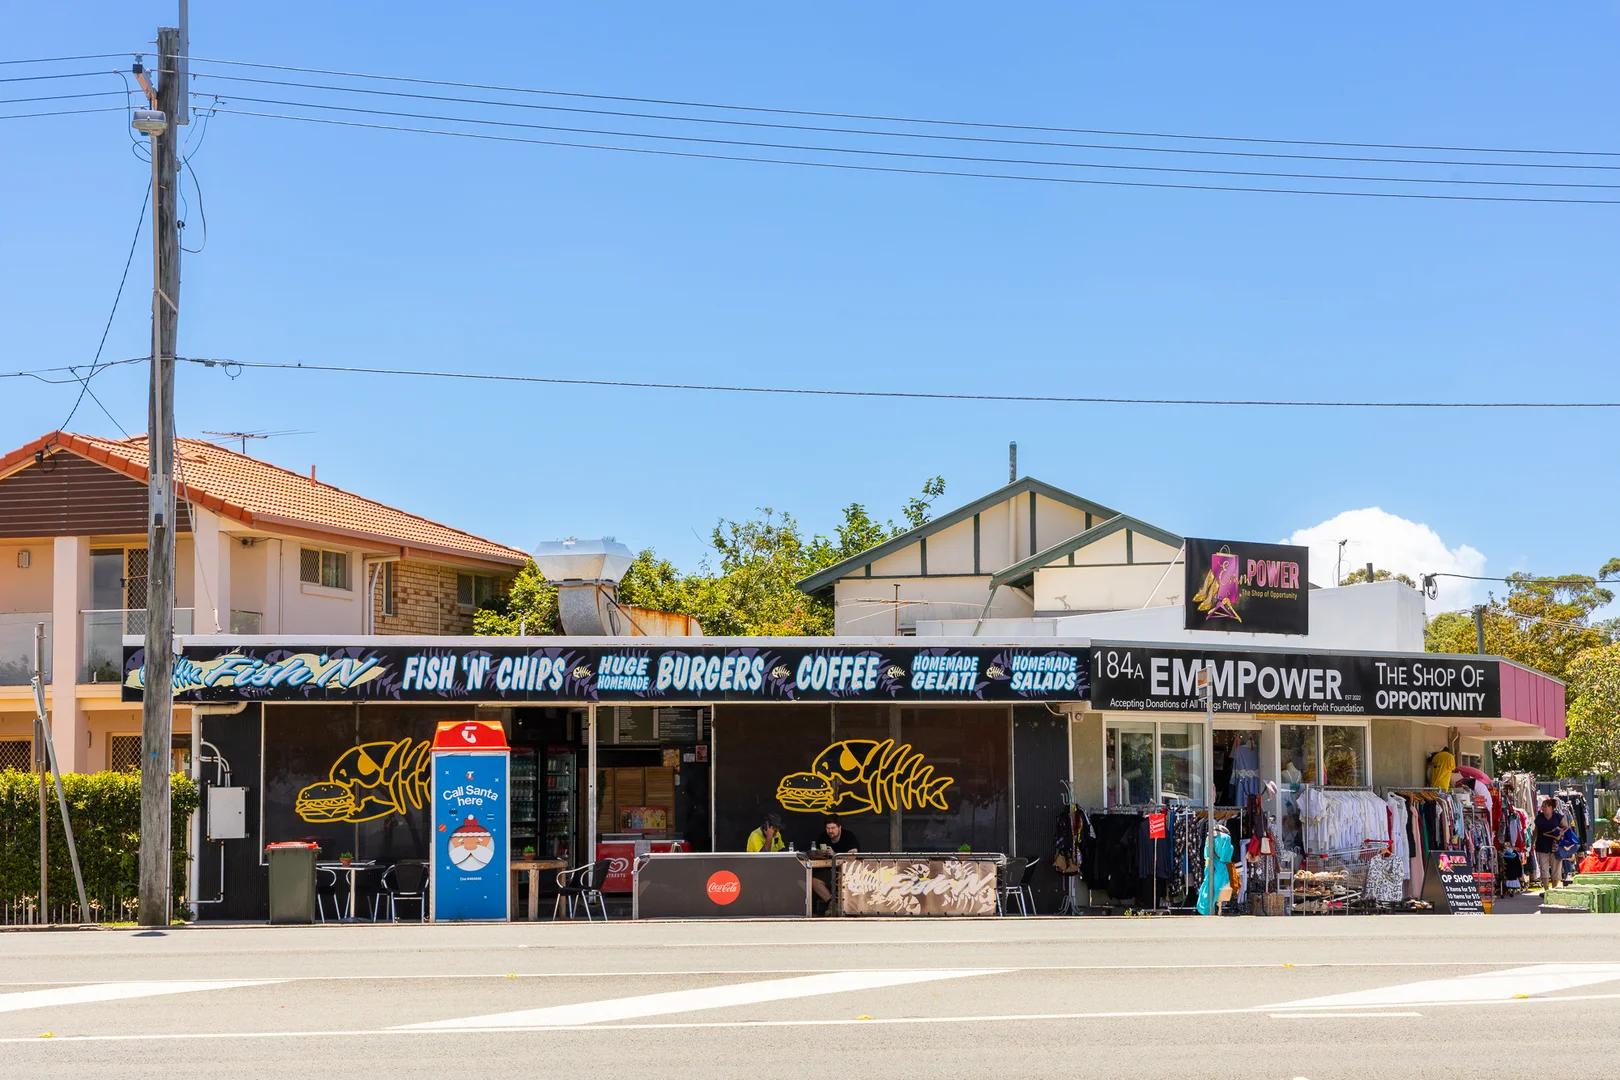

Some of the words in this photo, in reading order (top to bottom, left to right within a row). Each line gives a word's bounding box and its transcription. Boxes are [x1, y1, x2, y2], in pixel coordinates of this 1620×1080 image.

[1247, 559, 1299, 589] POWER
[1242, 589, 1250, 597] The
[1252, 590, 1262, 598] Shop
[1270, 590, 1297, 600] Opportunity
[402, 655, 456, 690] FISH
[462, 655, 490, 690] 'N'
[496, 655, 566, 690] CHIPS
[598, 655, 650, 676] HUGE
[656, 655, 764, 690] BURGERS
[796, 655, 880, 690] COFFEE
[912, 655, 979, 672] HOMEMADE
[1012, 655, 1078, 672] HOMEMADE
[1094, 650, 1144, 679] 184A
[596, 675, 650, 690] HOMEMADE
[911, 671, 977, 690] GELATI
[1010, 671, 1077, 690] SALADS
[1110, 698, 1144, 710] Accepting
[1146, 699, 1180, 709] Donations
[1181, 699, 1188, 708] of
[1189, 700, 1198, 709] All
[1200, 700, 1221, 712] Thgs
[1222, 701, 1241, 712] Pretty
[1250, 702, 1289, 712] Independant
[1290, 703, 1300, 711] not
[1302, 703, 1312, 711] for
[1312, 703, 1329, 712] Profit
[1330, 704, 1364, 712] Foundation
[1376, 690, 1485, 711] OPPORTUNITY
[443, 786, 464, 800] Call
[466, 785, 498, 801] Santa
[457, 797, 483, 806] here
[1442, 874, 1452, 882] OP
[1454, 874, 1473, 882] SHOP
